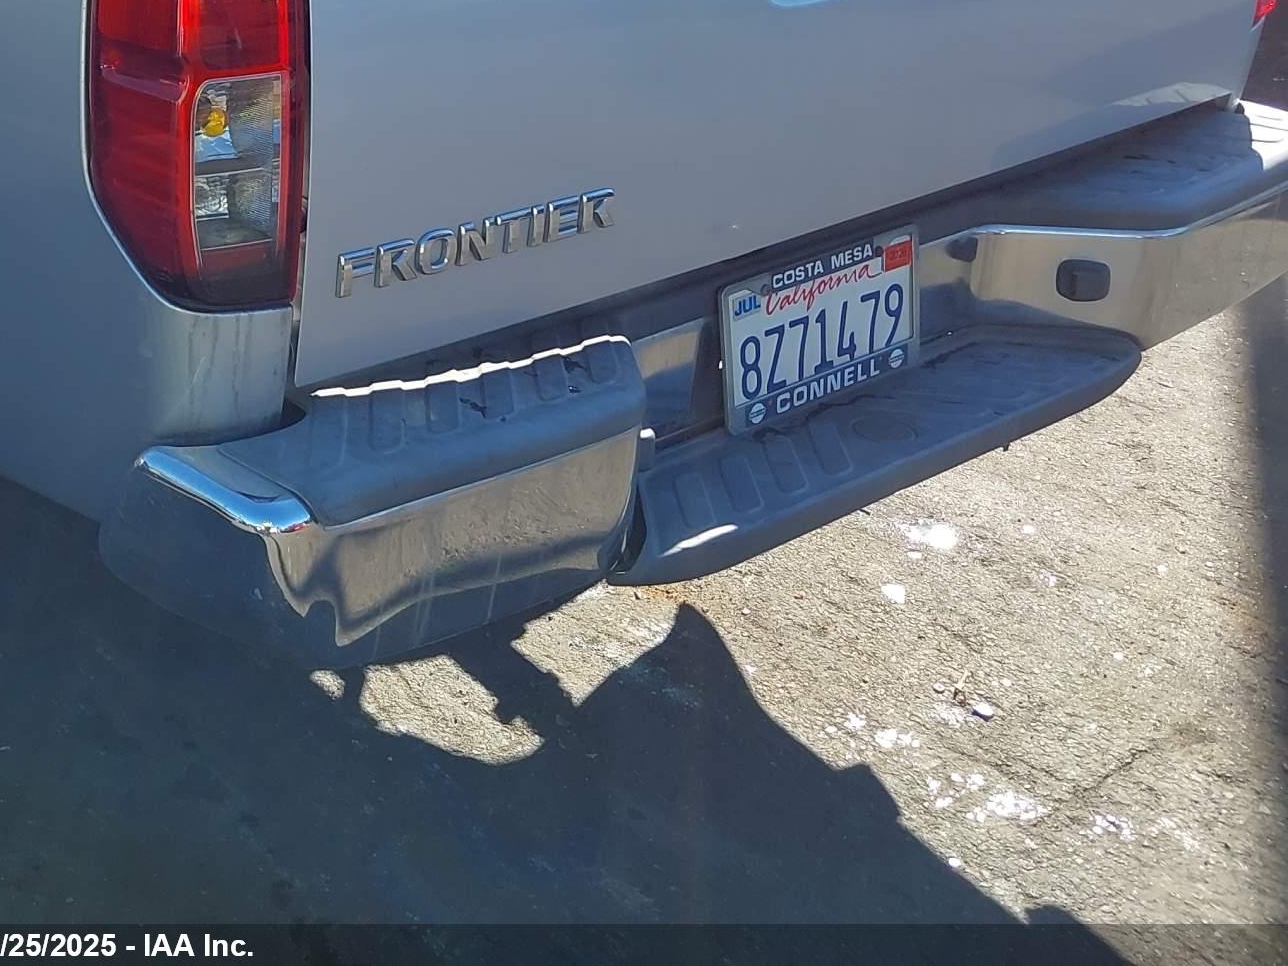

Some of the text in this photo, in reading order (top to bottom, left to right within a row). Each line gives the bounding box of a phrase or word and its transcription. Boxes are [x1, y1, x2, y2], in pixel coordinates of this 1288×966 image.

[335, 187, 616, 298] FRONTIER
[772, 260, 824, 288] COSTA
[831, 243, 873, 270] MESA
[734, 294, 761, 317] JUL
[765, 263, 883, 316] California
[739, 283, 904, 401] 8Z71479
[776, 358, 880, 414] CONNELL
